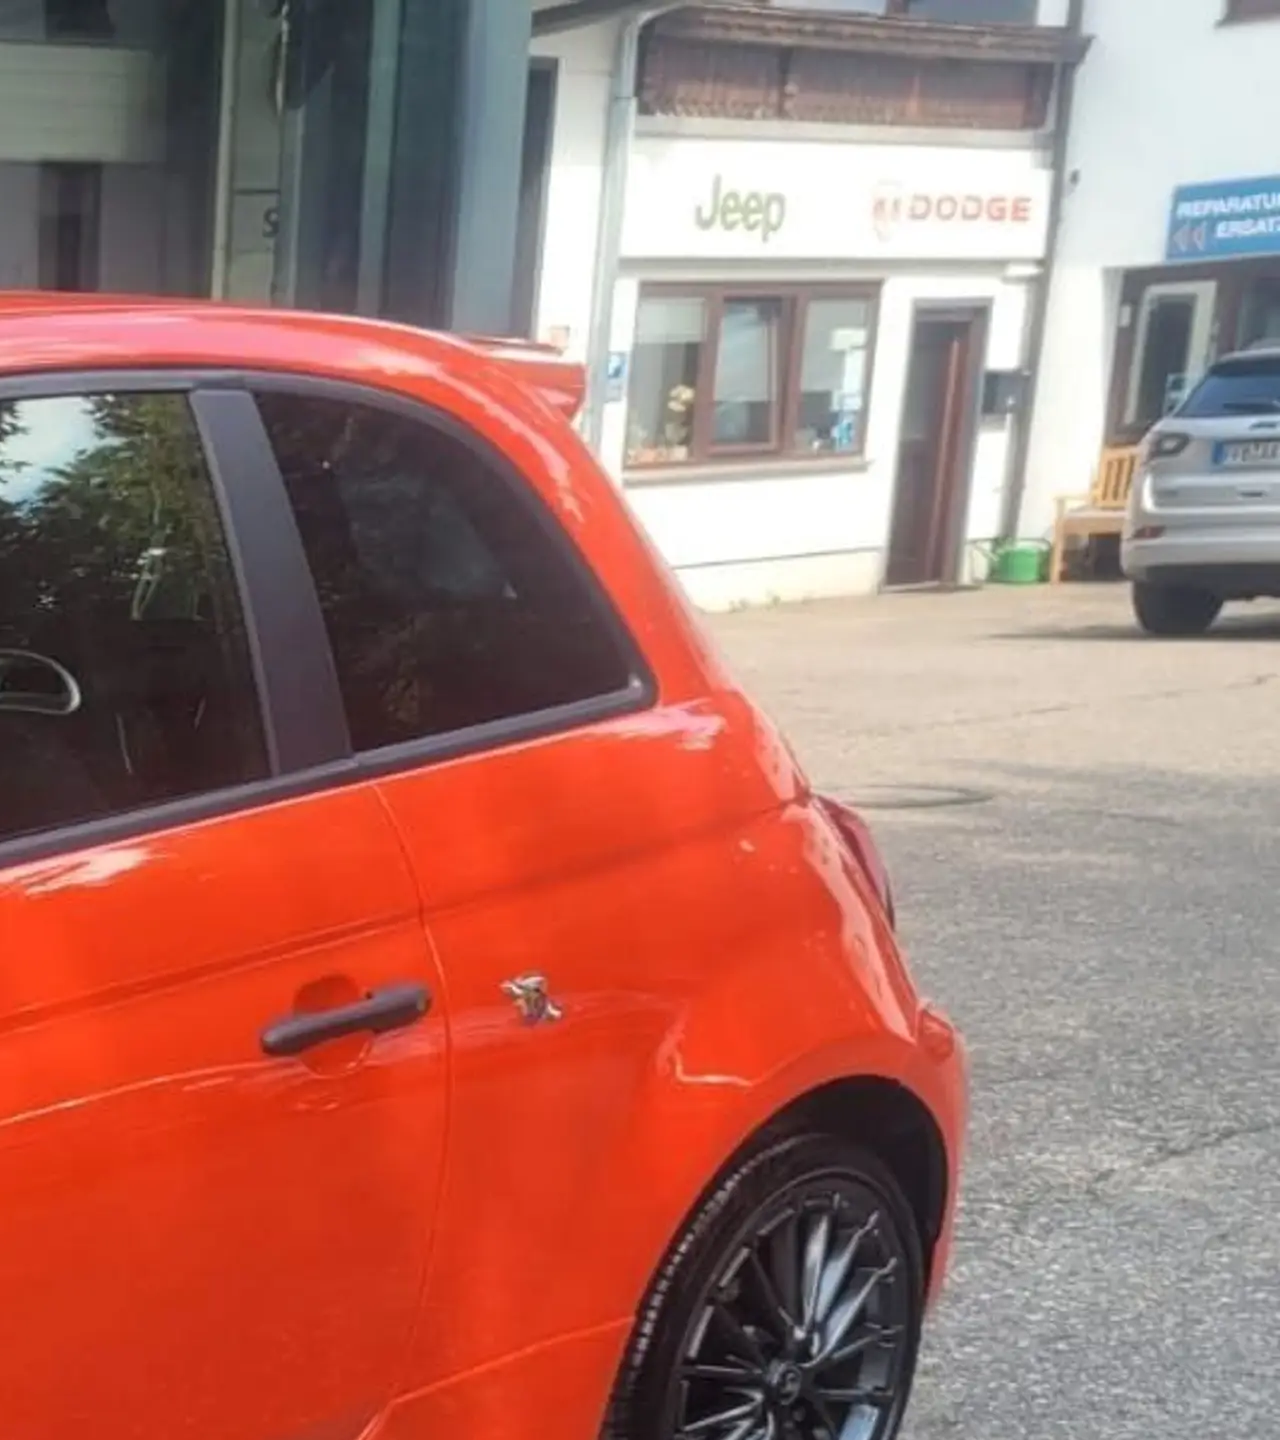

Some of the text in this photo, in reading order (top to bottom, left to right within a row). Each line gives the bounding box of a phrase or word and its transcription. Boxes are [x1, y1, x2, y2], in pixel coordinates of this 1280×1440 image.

[695, 173, 787, 243] Jeep
[908, 193, 1032, 223] DODGE
[1176, 192, 1280, 218] REPARATU
